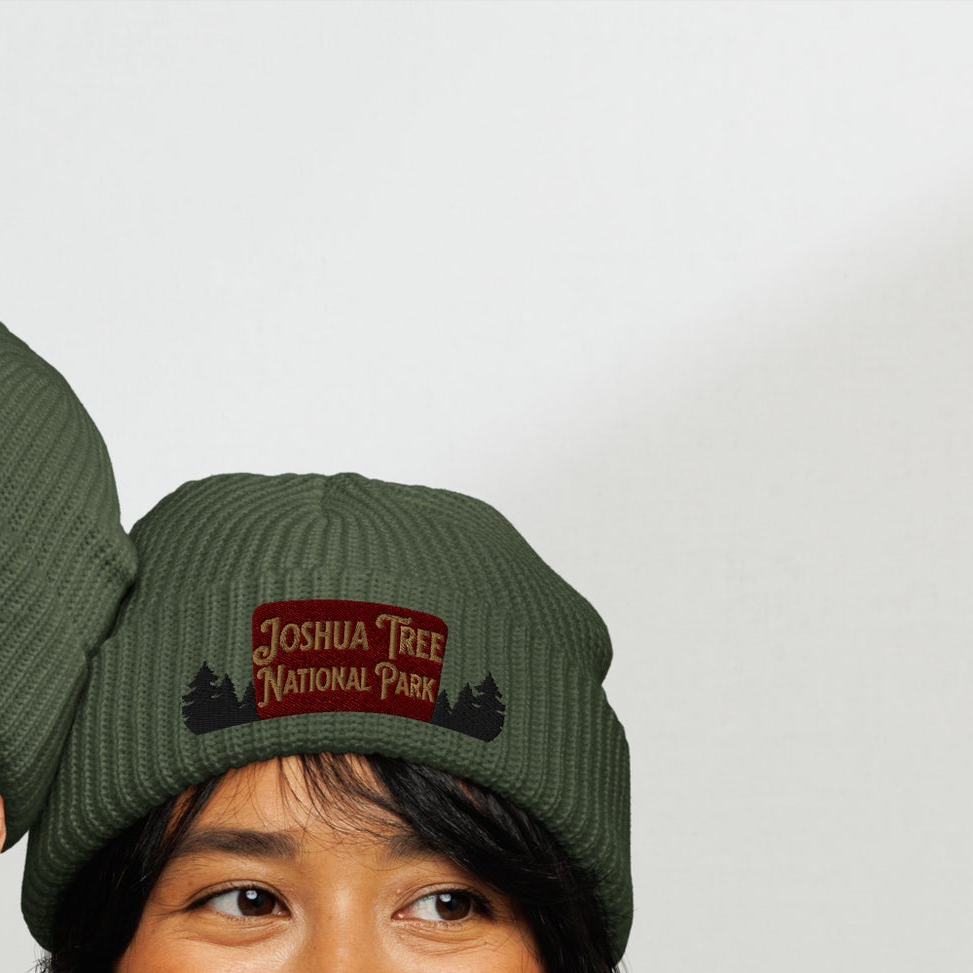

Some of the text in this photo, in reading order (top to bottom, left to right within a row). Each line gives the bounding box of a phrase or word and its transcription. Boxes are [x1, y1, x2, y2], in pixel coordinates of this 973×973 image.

[252, 613, 447, 666] JOSHUA TREE
[256, 661, 436, 708] NATIONAL PARK
